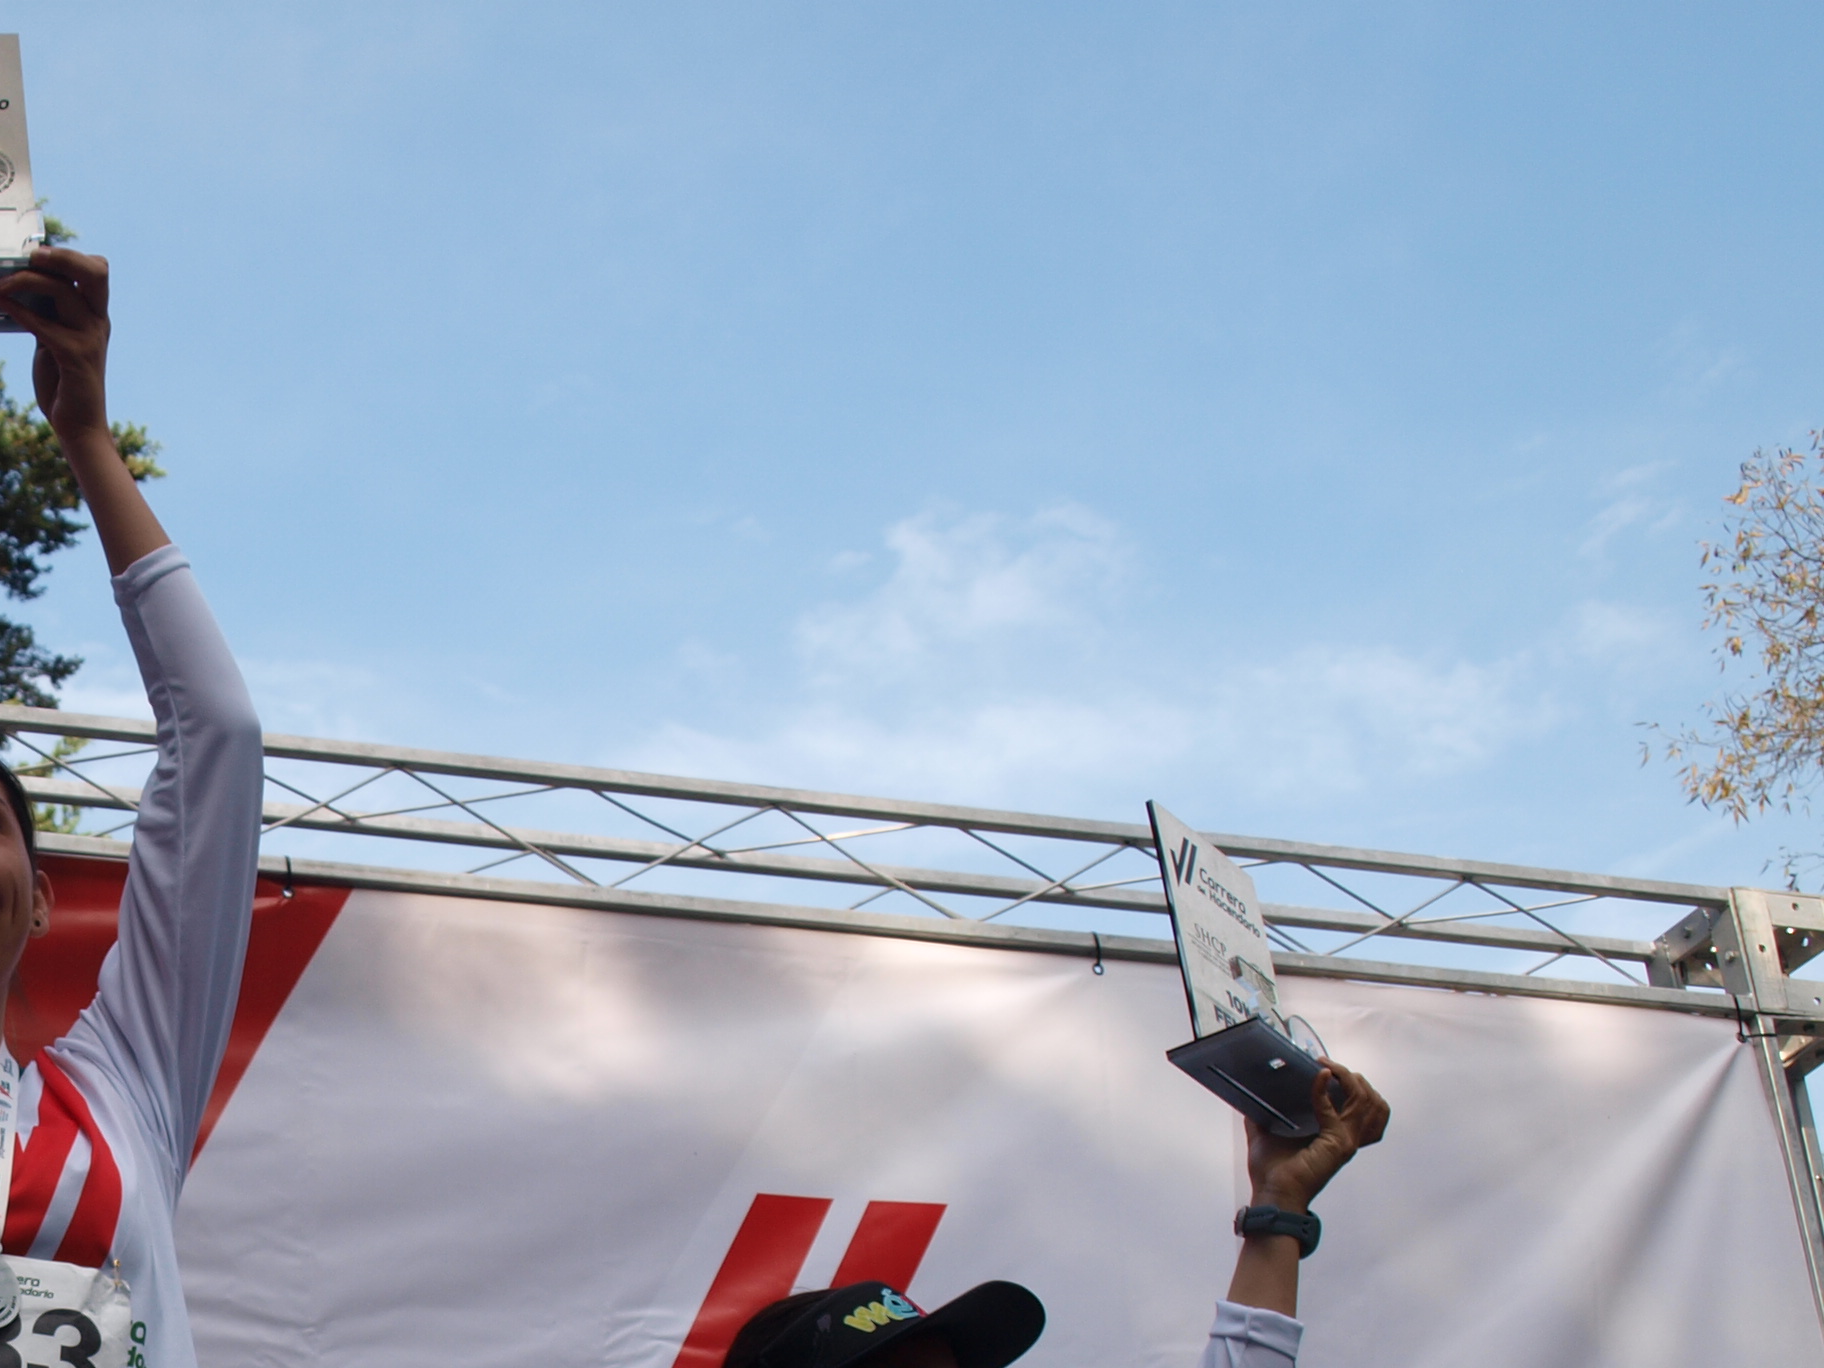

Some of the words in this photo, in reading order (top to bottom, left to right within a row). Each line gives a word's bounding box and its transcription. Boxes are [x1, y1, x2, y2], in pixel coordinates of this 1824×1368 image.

[1199, 866, 1247, 916] Carrera
[1209, 888, 1261, 939] Hacendario
[1194, 922, 1227, 956] SHCP
